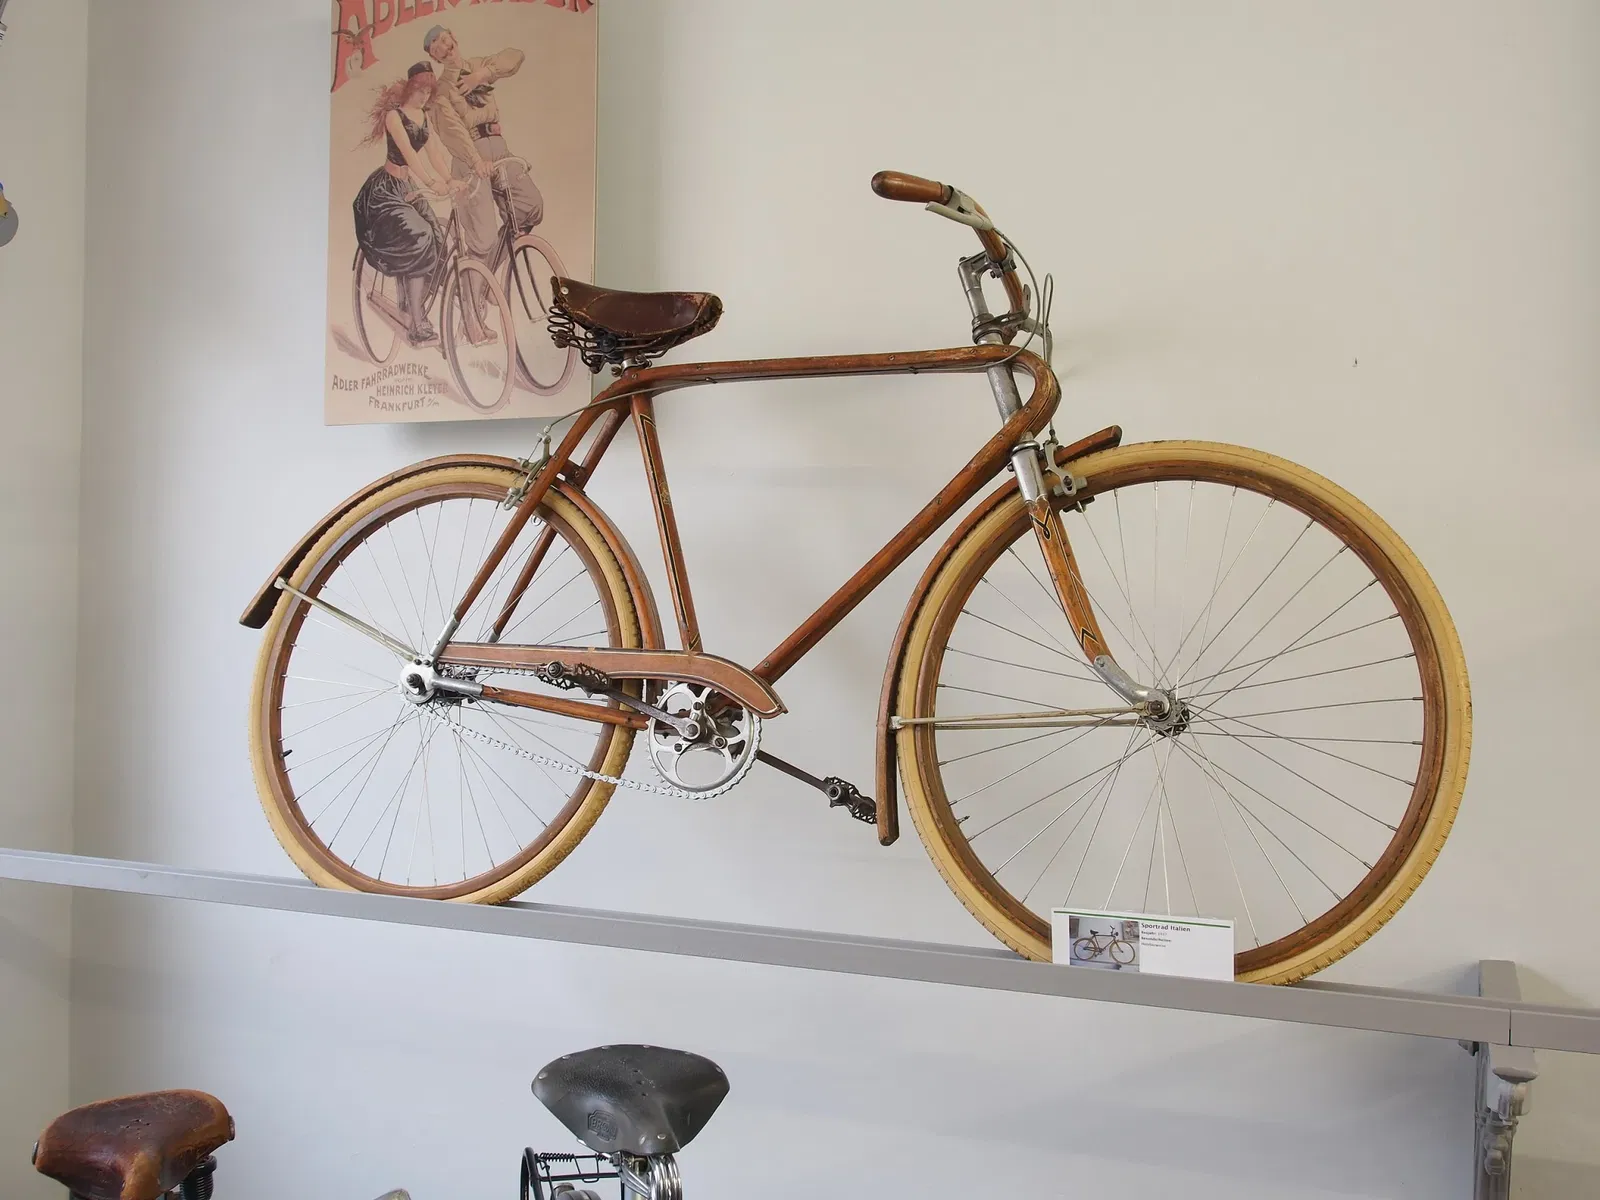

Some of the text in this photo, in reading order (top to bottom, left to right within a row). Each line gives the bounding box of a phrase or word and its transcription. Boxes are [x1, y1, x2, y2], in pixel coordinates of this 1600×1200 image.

[332, 363, 432, 391] ADLER FAHRRADWERKE
[376, 385, 415, 397] HEINRICH
[369, 395, 426, 412] FRANKFURT
